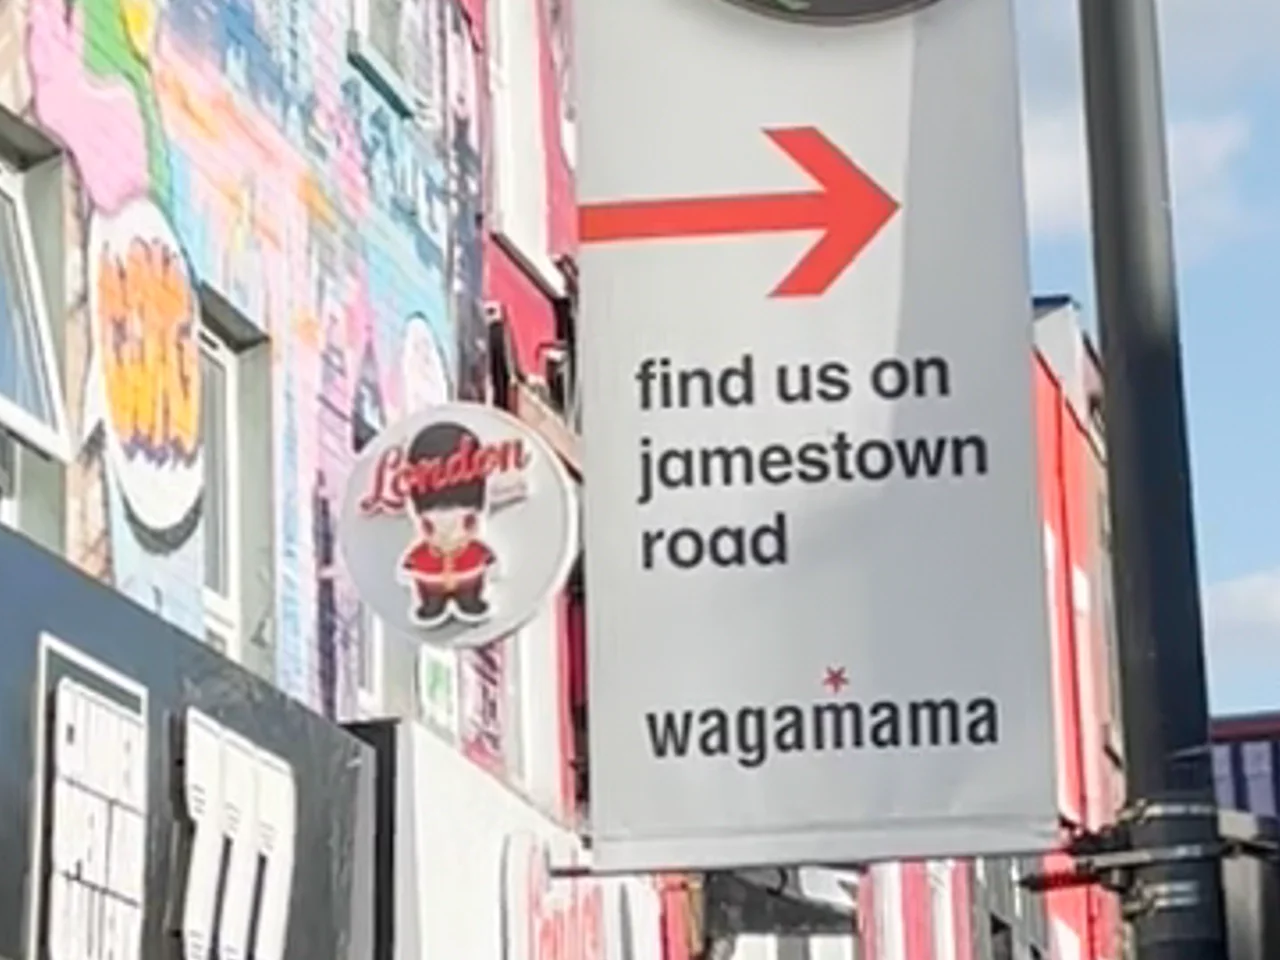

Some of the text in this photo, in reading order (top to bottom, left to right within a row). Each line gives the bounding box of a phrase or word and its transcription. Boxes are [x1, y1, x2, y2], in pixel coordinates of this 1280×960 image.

[635, 354, 951, 411] find us on
[359, 436, 532, 516] London
[637, 431, 989, 504] jamestown
[642, 512, 789, 570] road
[646, 697, 1001, 768] wagamama
